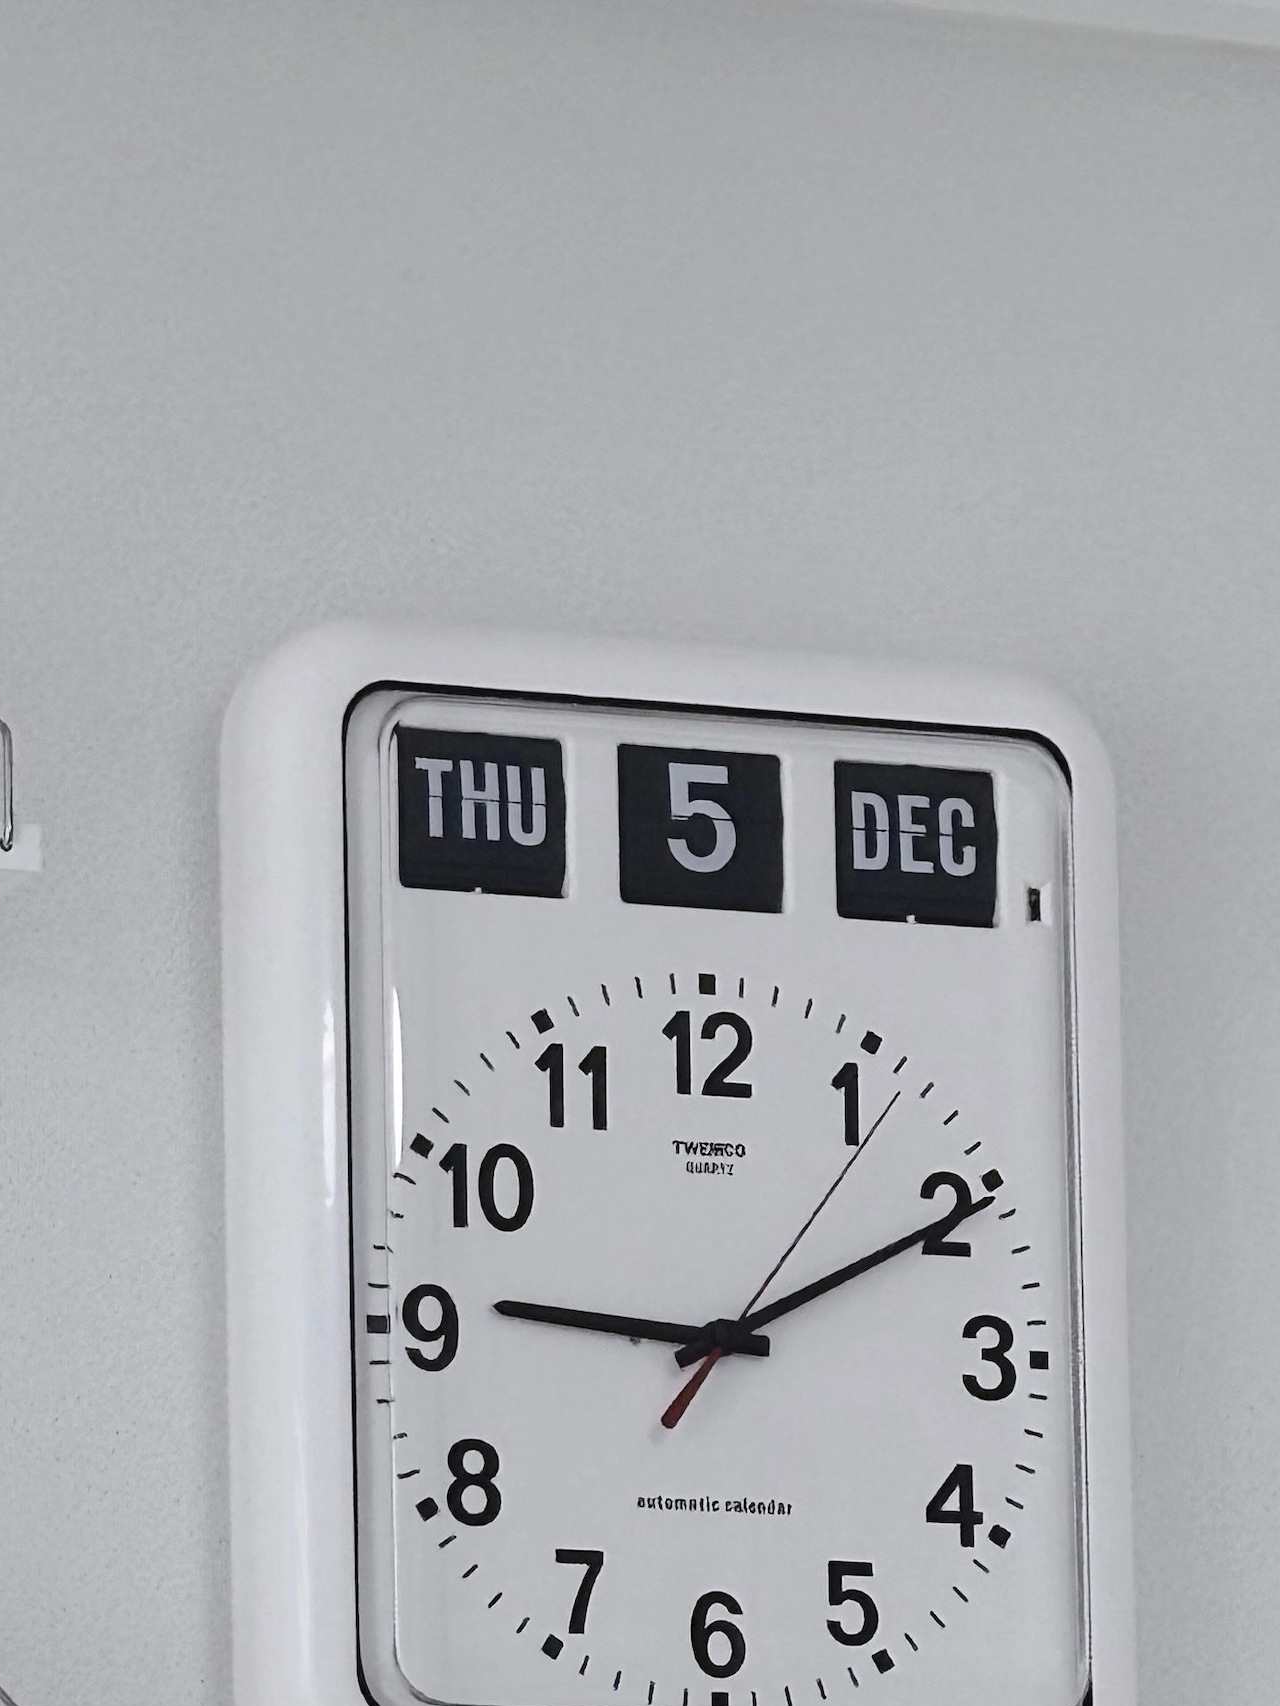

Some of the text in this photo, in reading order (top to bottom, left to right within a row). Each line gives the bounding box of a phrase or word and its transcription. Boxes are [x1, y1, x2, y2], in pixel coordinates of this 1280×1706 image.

[414, 756, 547, 846] THU
[667, 762, 737, 873] 5
[851, 790, 976, 877] DEC
[534, 1042, 608, 1131] 11
[661, 1010, 753, 1099] 12
[830, 1062, 860, 1148] 1
[438, 1142, 535, 1233] 10
[920, 1171, 972, 1257] 2
[401, 1283, 459, 1372] 9
[962, 1314, 1017, 1402] 3
[446, 1438, 502, 1527] 8
[636, 1495, 793, 1516] automatic calendar
[925, 1463, 984, 1548] 4
[554, 1548, 605, 1635] 7
[690, 1590, 746, 1679] 6
[826, 1560, 879, 1647] 5
